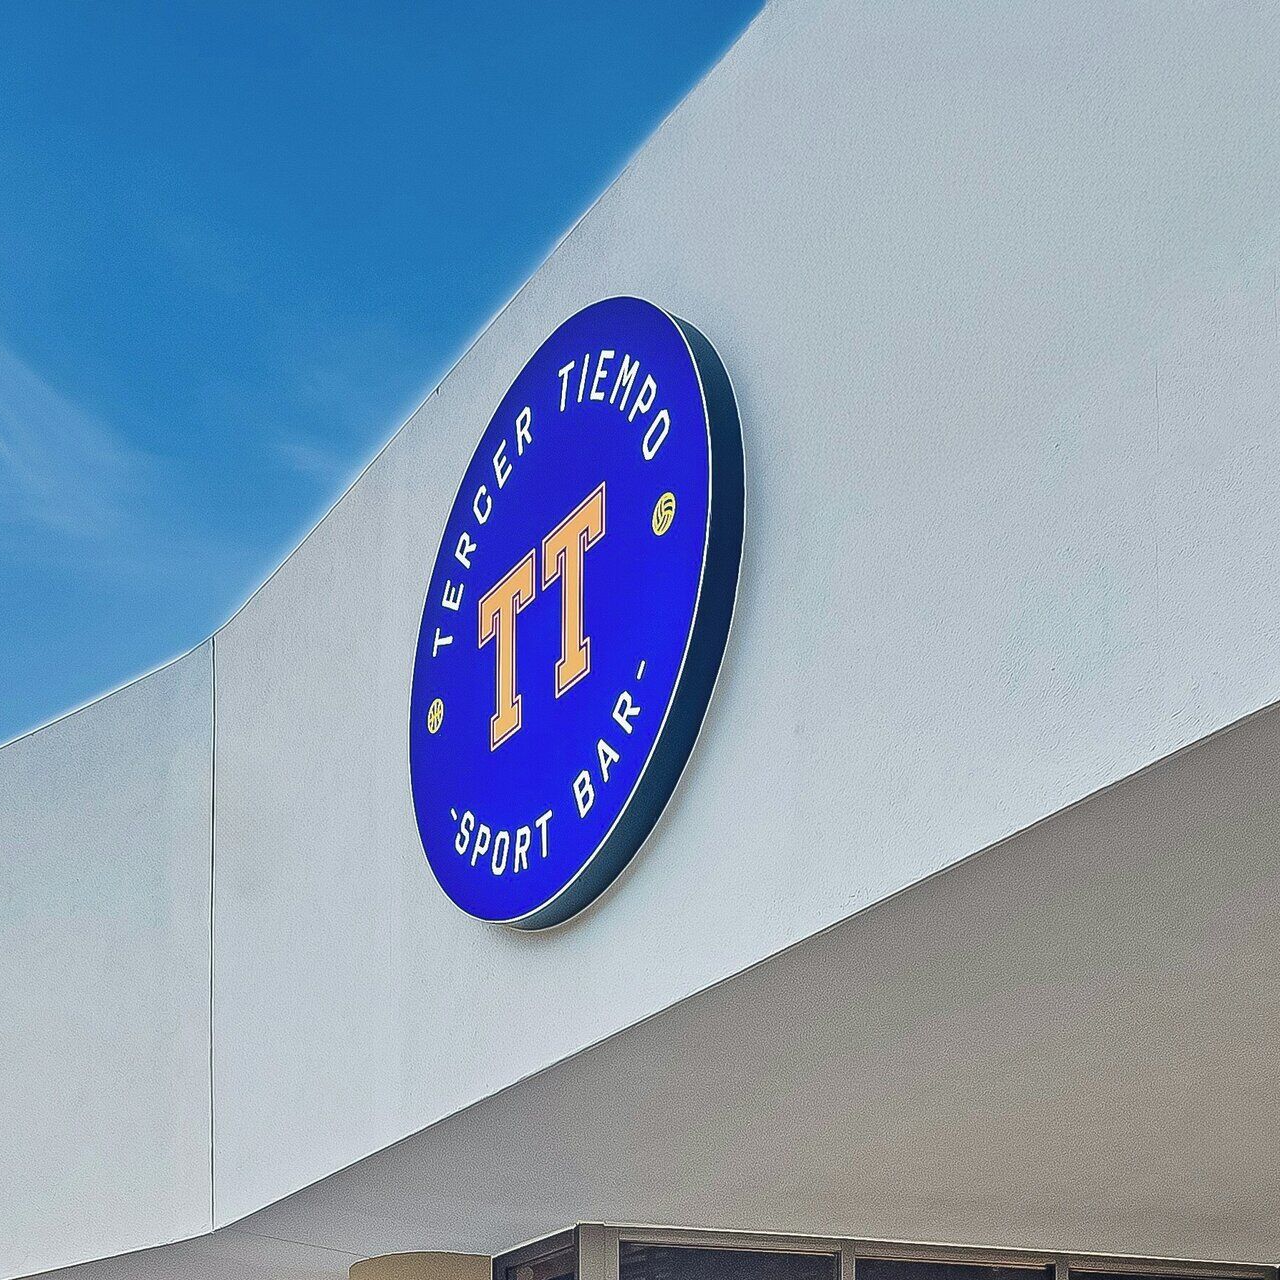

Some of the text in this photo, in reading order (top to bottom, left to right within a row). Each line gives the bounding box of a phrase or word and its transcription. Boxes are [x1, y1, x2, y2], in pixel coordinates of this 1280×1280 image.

[431, 349, 671, 658] TERCER TIEMPO
[477, 480, 606, 752] TT
